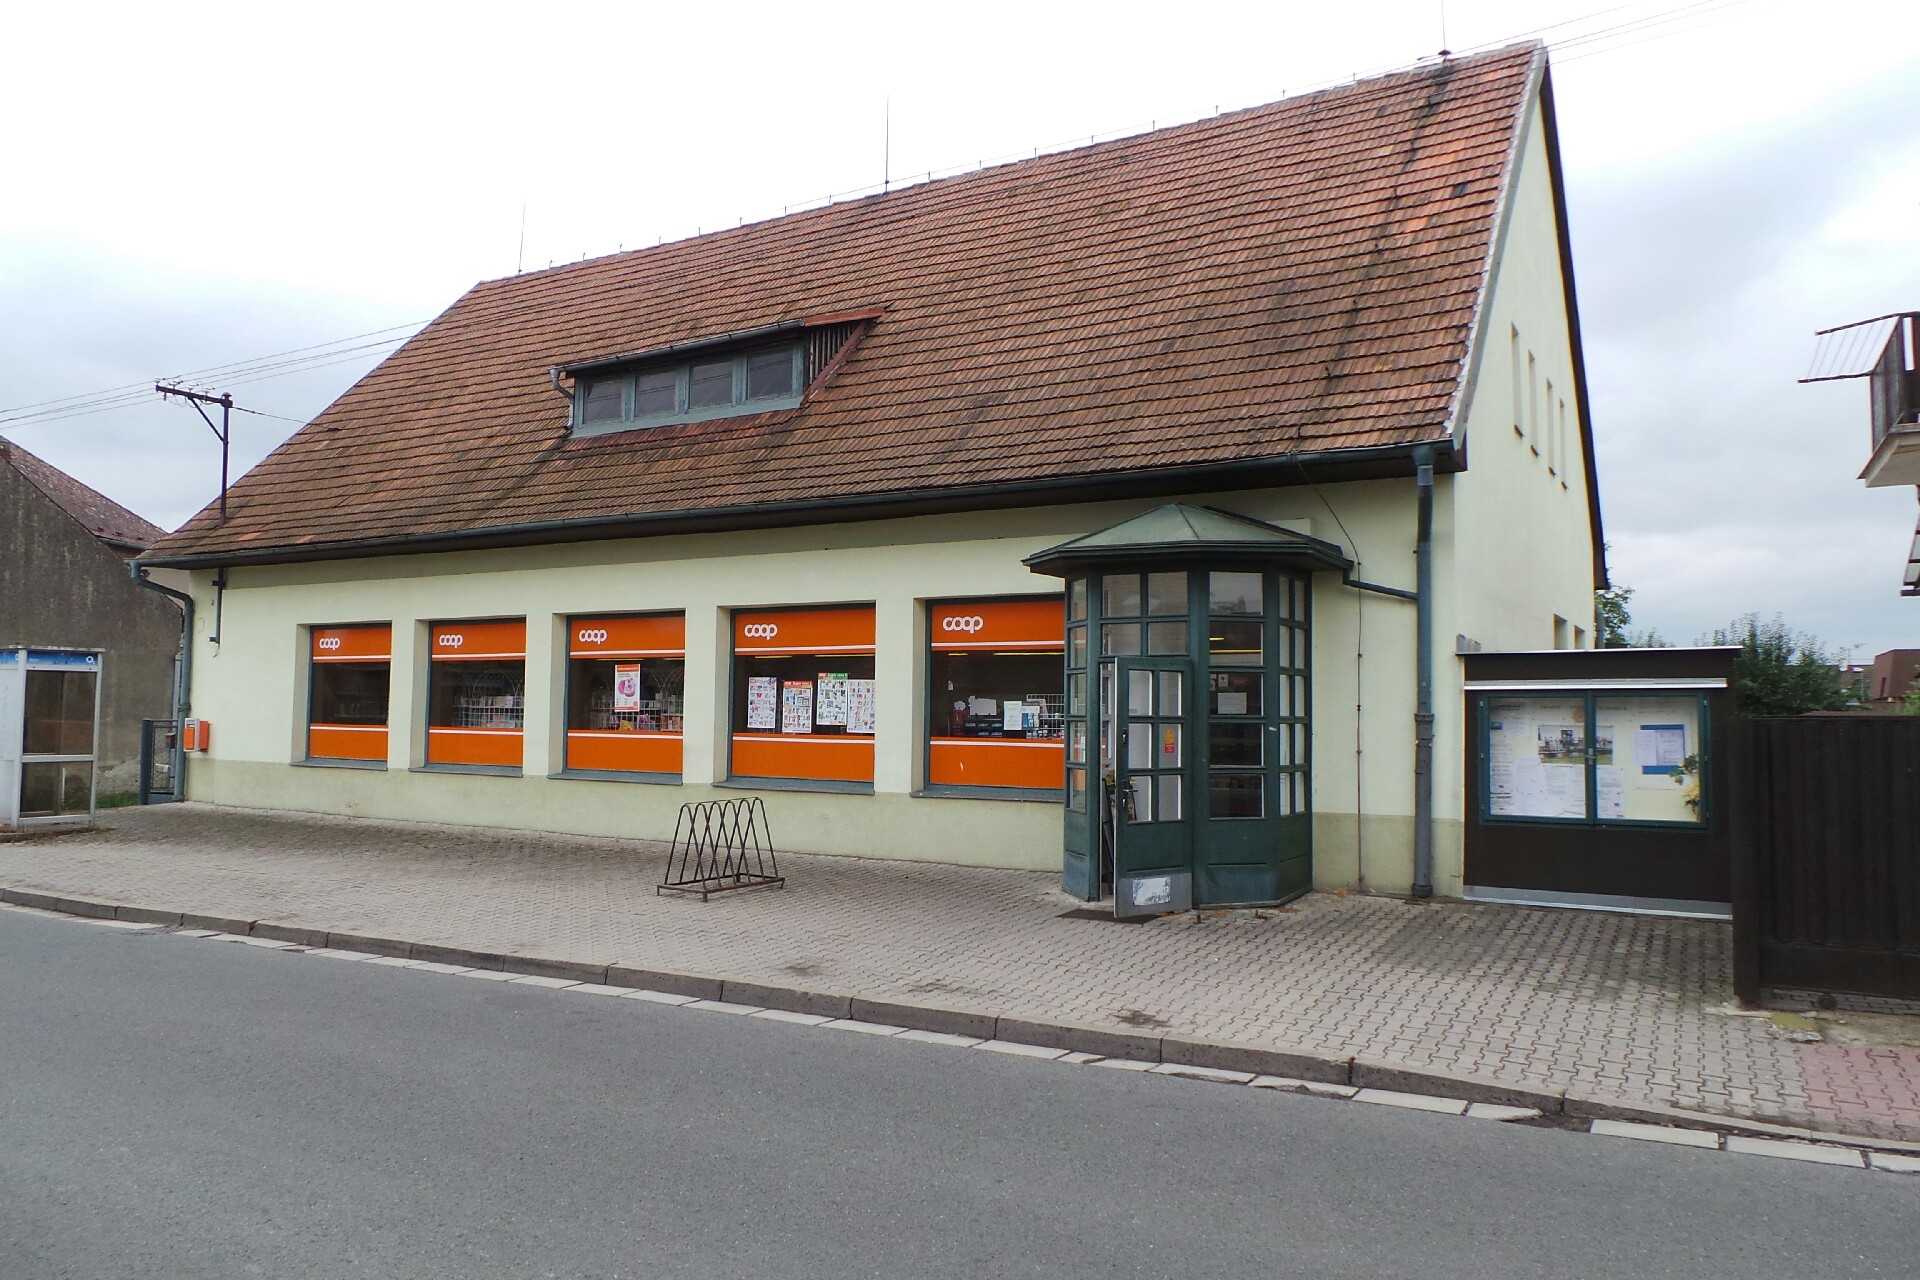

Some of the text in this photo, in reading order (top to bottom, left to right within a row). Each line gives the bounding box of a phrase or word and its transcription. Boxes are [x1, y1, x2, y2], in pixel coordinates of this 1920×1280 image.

[744, 623, 778, 640] coop
[943, 615, 984, 634] coop
[319, 637, 341, 650] coop
[439, 634, 463, 648] coop
[578, 629, 607, 645] coop
